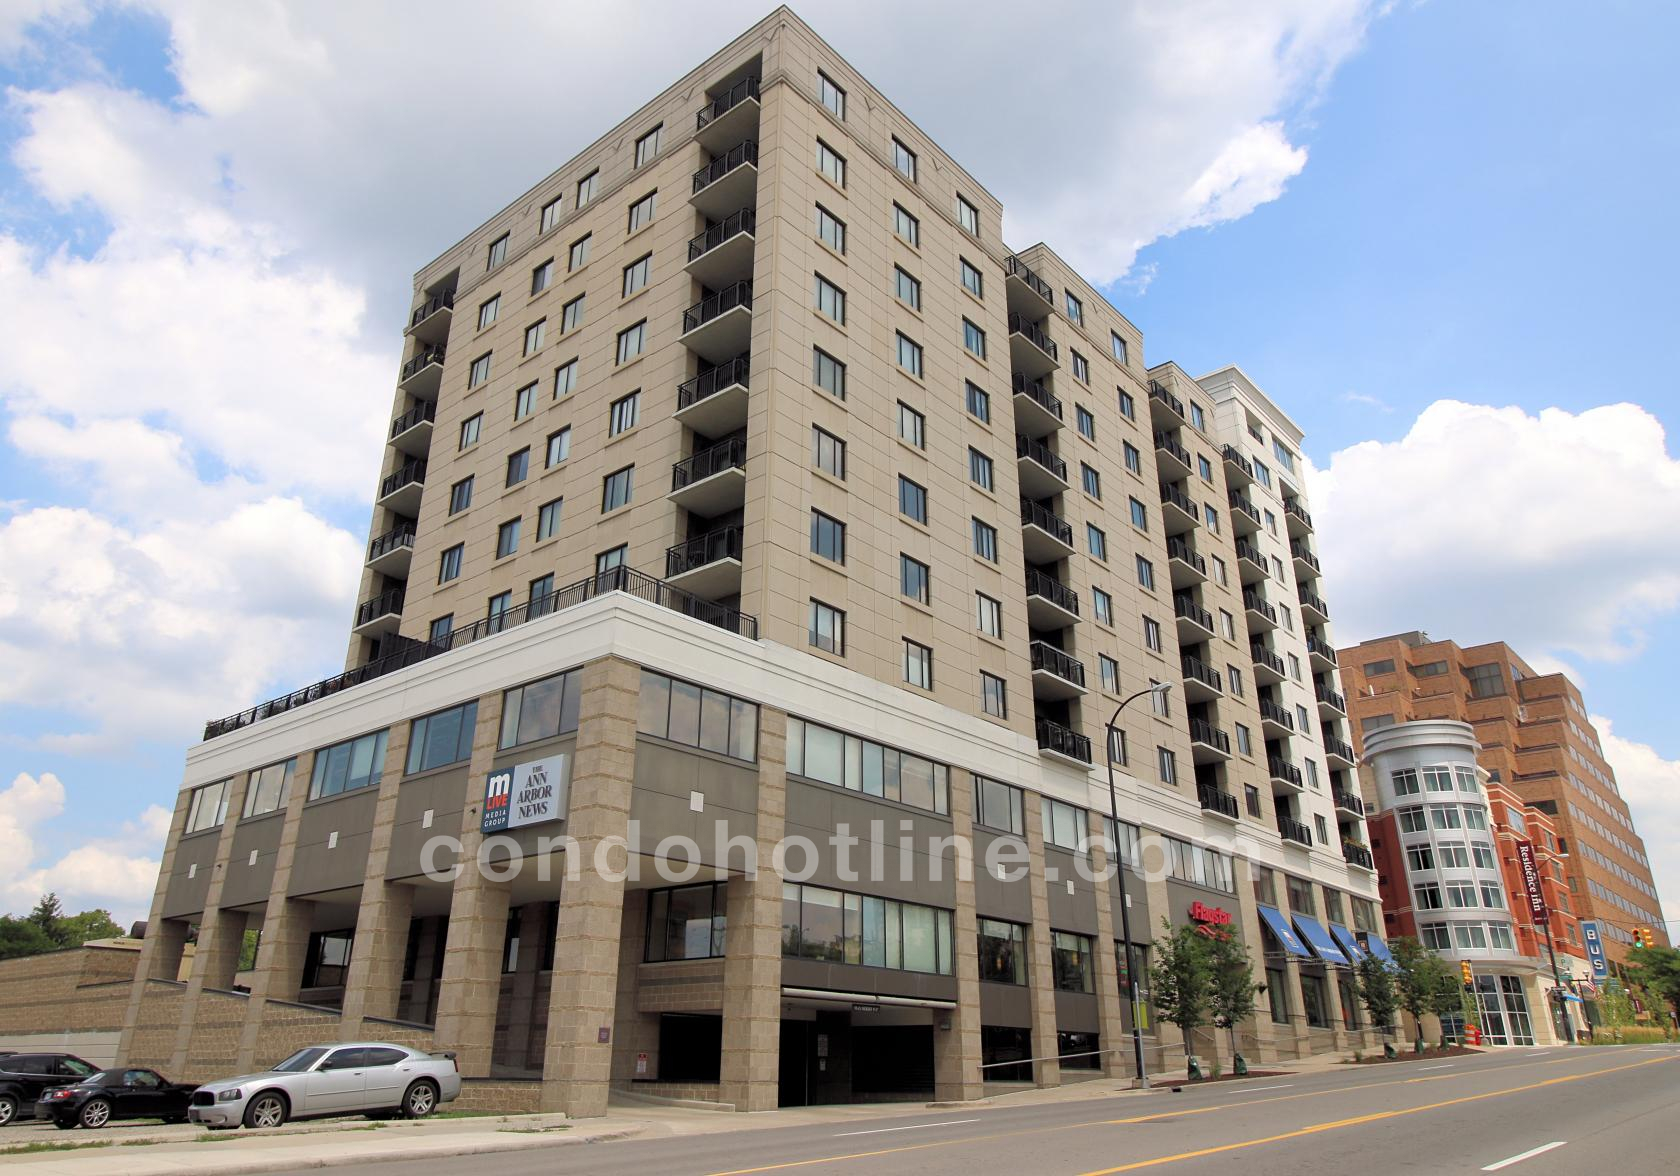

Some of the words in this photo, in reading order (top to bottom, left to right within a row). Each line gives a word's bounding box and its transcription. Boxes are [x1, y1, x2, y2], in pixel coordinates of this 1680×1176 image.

[532, 765, 543, 773] THE
[525, 772, 548, 788] ANN
[486, 794, 508, 810] LIVE
[517, 785, 552, 804] ARBOR
[485, 809, 506, 819] MEDIA
[518, 801, 548, 819] NEWS
[484, 818, 505, 827] GROUP
[1520, 846, 1537, 893] Residence
[1192, 900, 1232, 925] Flagstar
[1586, 929, 1604, 970] BUS
